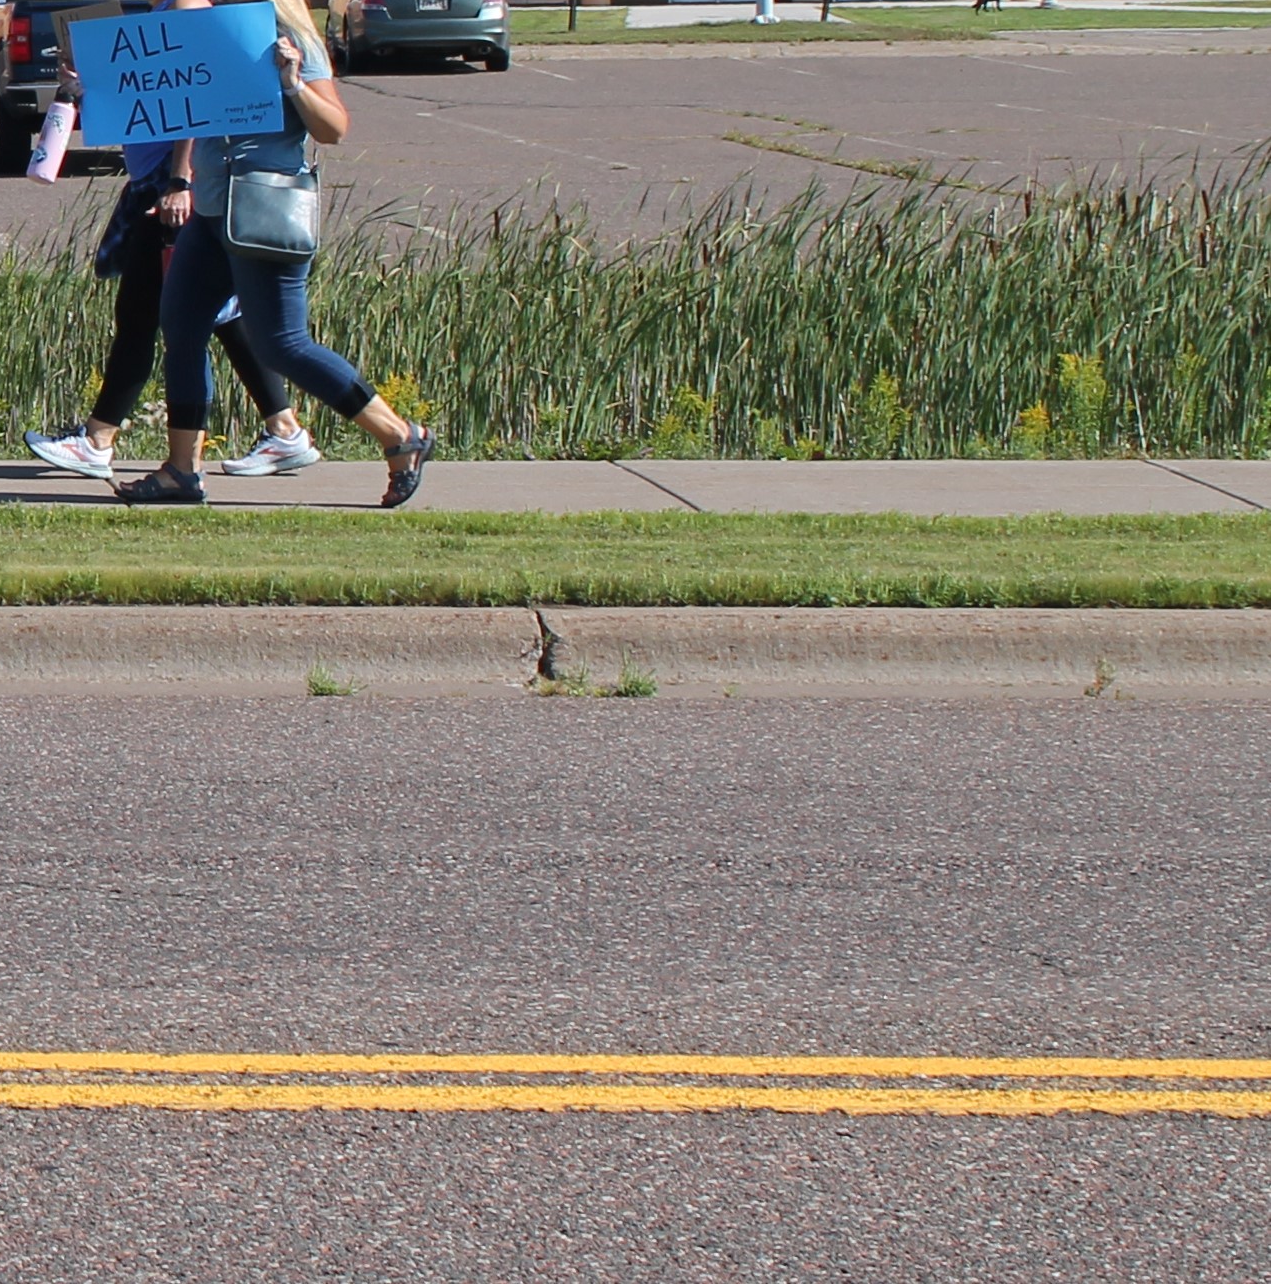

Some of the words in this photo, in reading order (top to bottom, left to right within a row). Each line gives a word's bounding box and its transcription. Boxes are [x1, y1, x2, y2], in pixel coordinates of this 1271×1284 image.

[110, 22, 183, 63] ALL
[118, 62, 212, 94] MEANS
[125, 96, 210, 137] ALL
